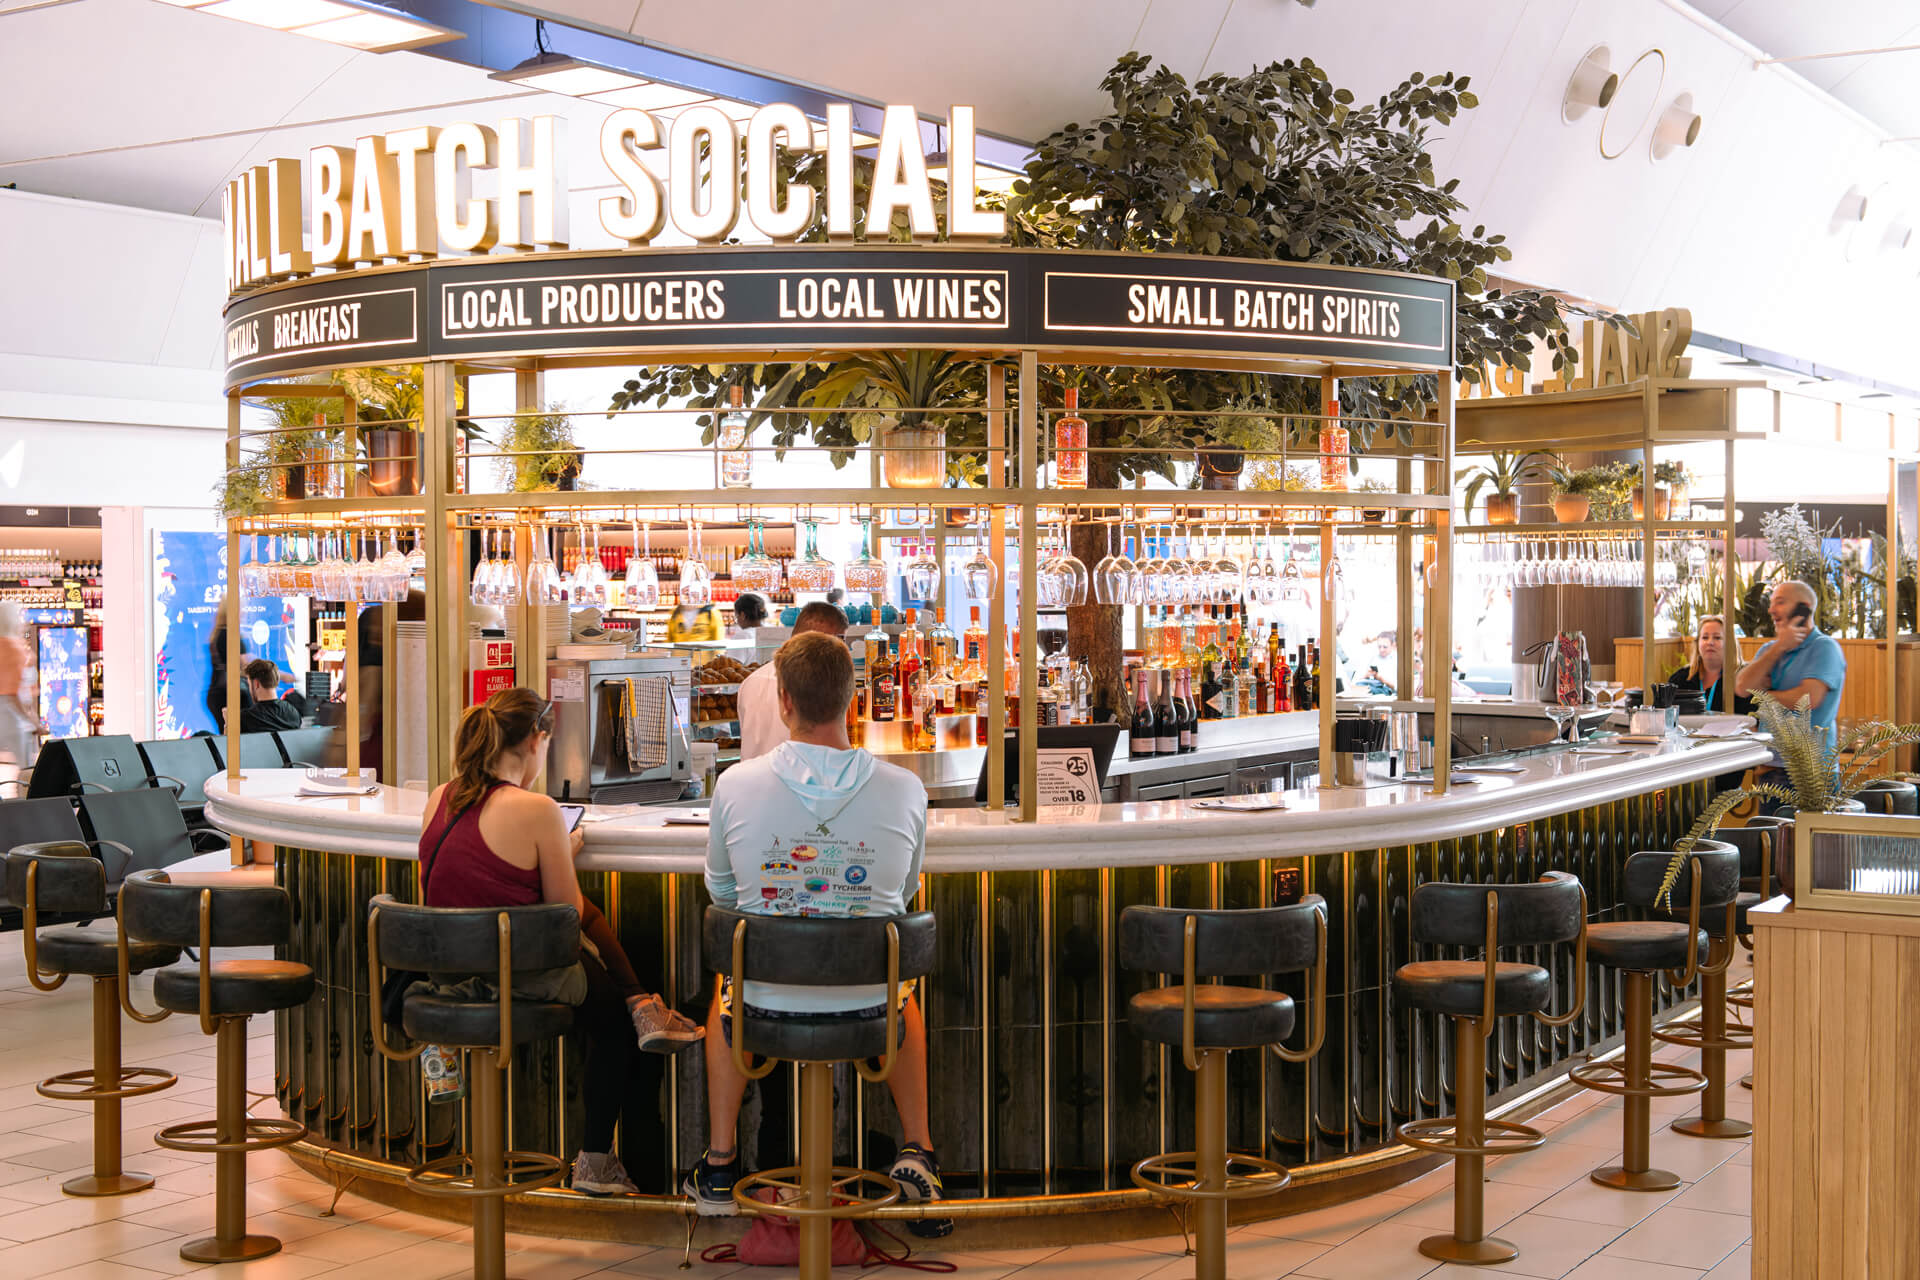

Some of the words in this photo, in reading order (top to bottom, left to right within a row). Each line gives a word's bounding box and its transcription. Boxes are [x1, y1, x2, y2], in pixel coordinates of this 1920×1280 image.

[222, 157, 297, 299] MALL
[310, 114, 562, 266] BATCH
[599, 102, 1007, 240] SOCIAL
[274, 302, 361, 350] BREAKFAST
[448, 287, 532, 330] LOCAL
[543, 279, 726, 325] PRODUCERS
[778, 278, 885, 319] LOCAL
[893, 278, 1002, 319] WINES
[1128, 283, 1225, 326] SMALL
[1234, 288, 1315, 331] BATCH
[1322, 294, 1401, 338] SPIRITS
[1068, 759, 1087, 773] 25
[1068, 789, 1086, 802] 18
